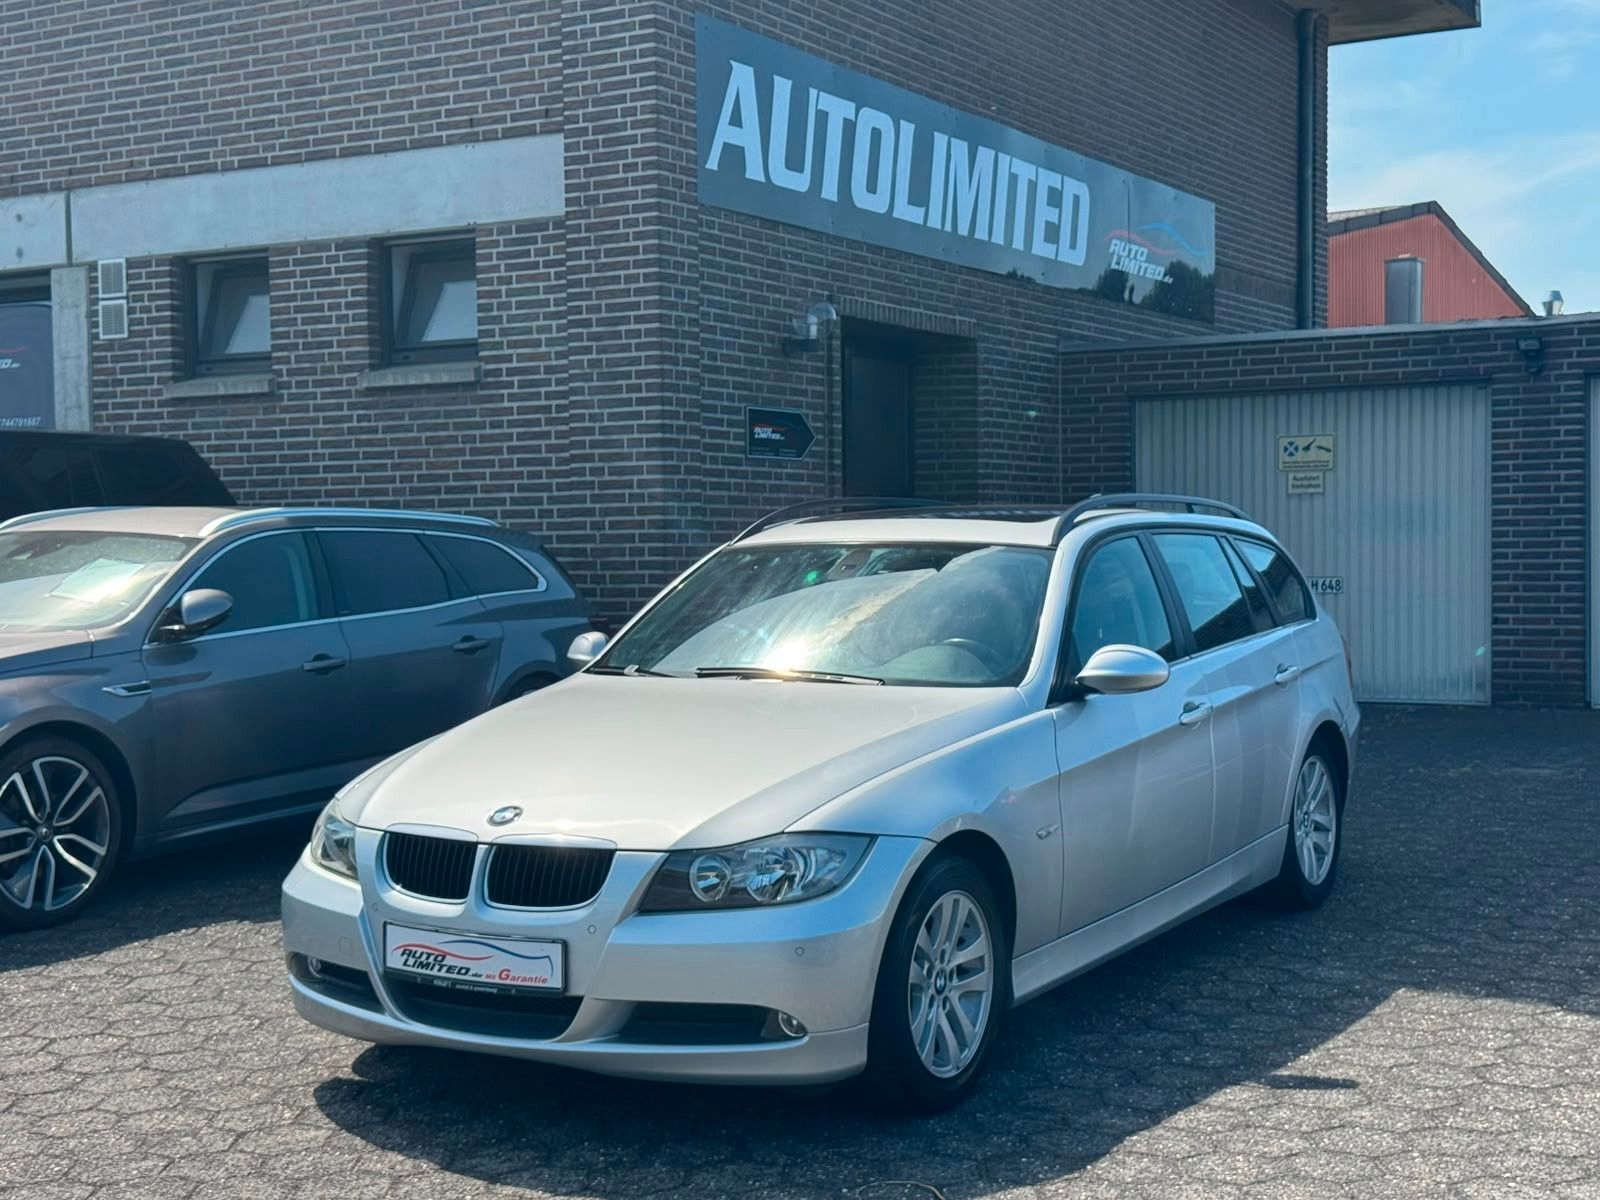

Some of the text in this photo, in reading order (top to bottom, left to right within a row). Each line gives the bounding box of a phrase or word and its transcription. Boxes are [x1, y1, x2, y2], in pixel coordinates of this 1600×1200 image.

[705, 59, 1090, 266] AUTOLIMITED
[1109, 239, 1148, 261] AUTO
[1320, 579, 1341, 592] 648
[400, 948, 448, 963] AUTO
[498, 968, 548, 985] Garantie
